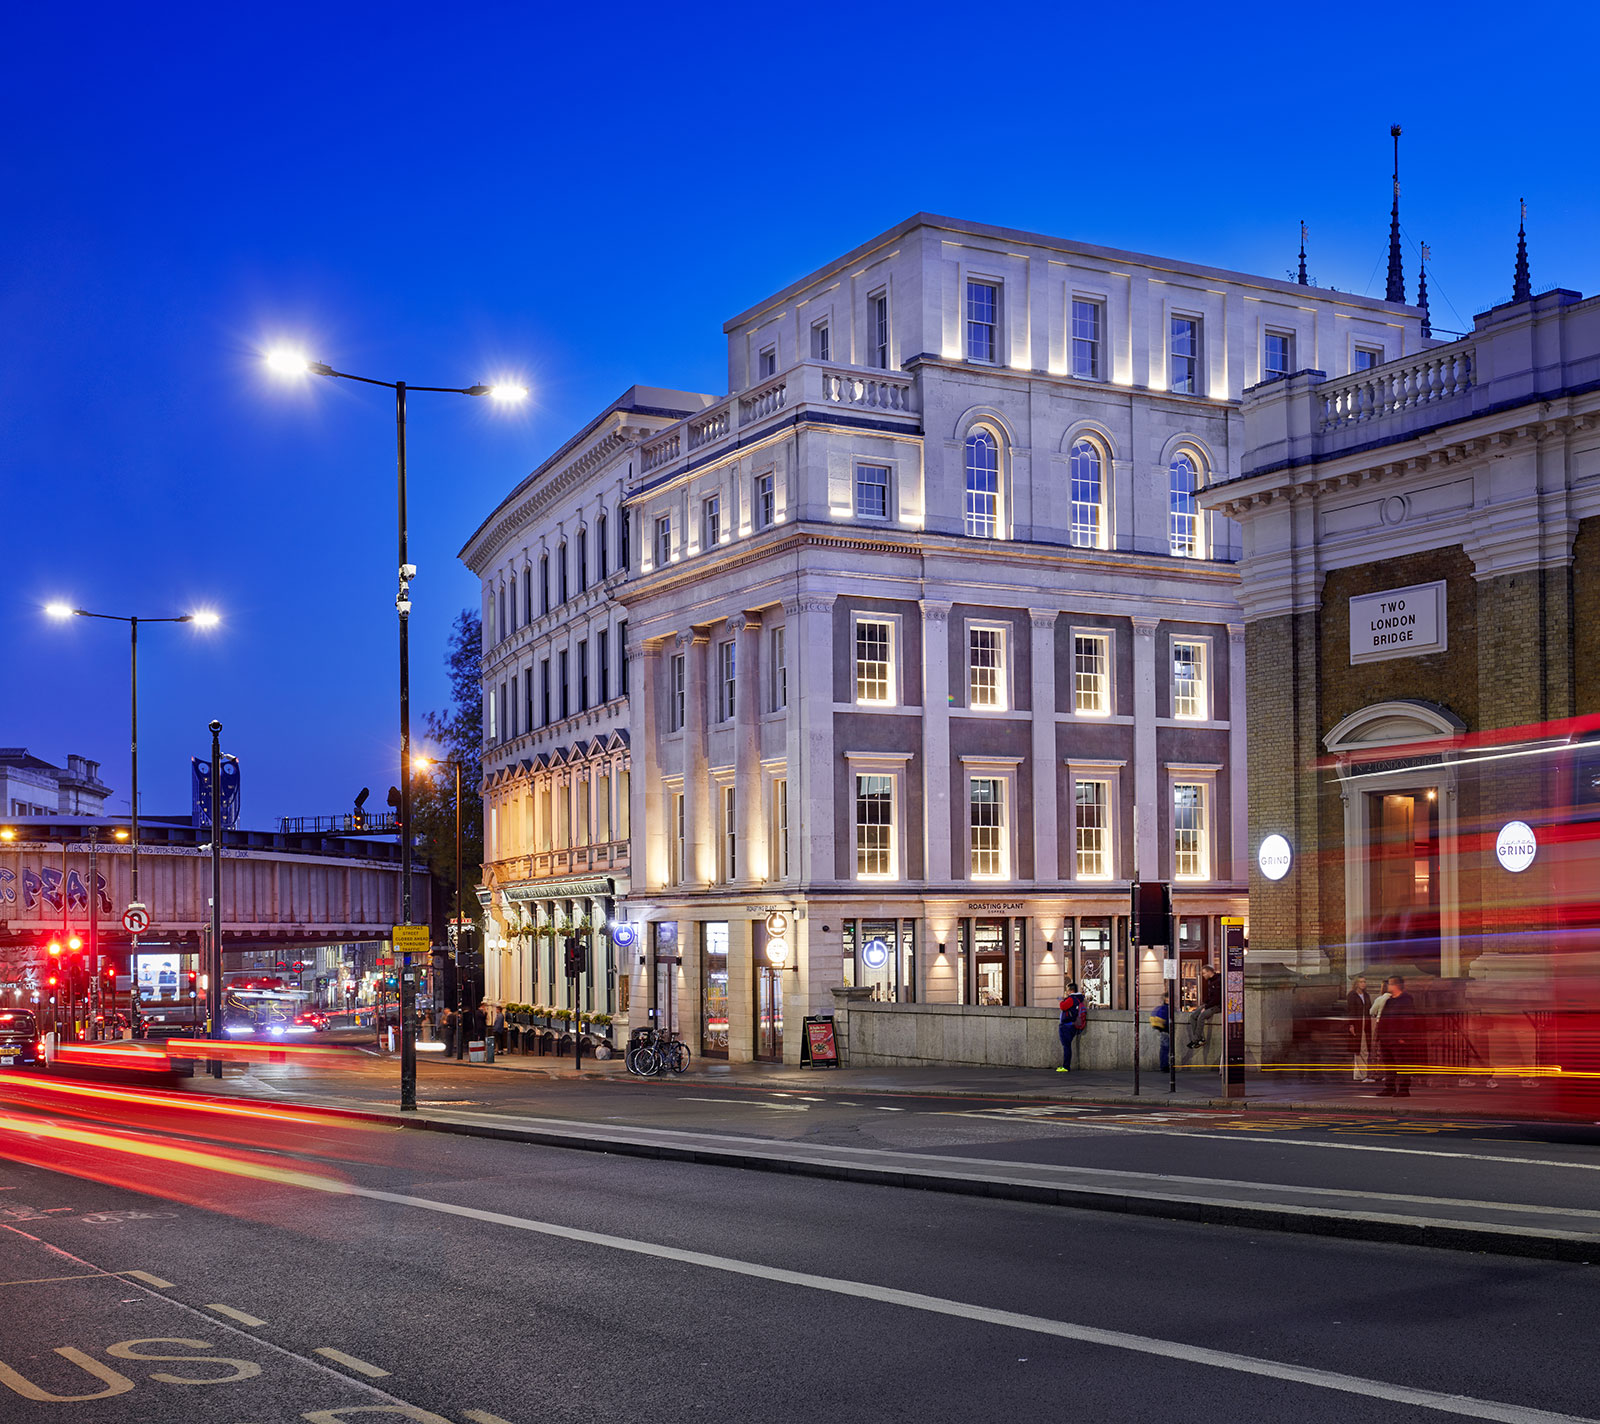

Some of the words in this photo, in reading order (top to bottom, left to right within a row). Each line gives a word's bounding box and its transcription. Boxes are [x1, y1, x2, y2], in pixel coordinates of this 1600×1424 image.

[1380, 600, 1406, 614] TWO
[1371, 614, 1416, 631] LONDON
[1373, 630, 1414, 646] BRIDGE
[1375, 759, 1409, 772] LONDON
[1499, 845, 1534, 855] GRIND
[1260, 855, 1289, 866] GRIND
